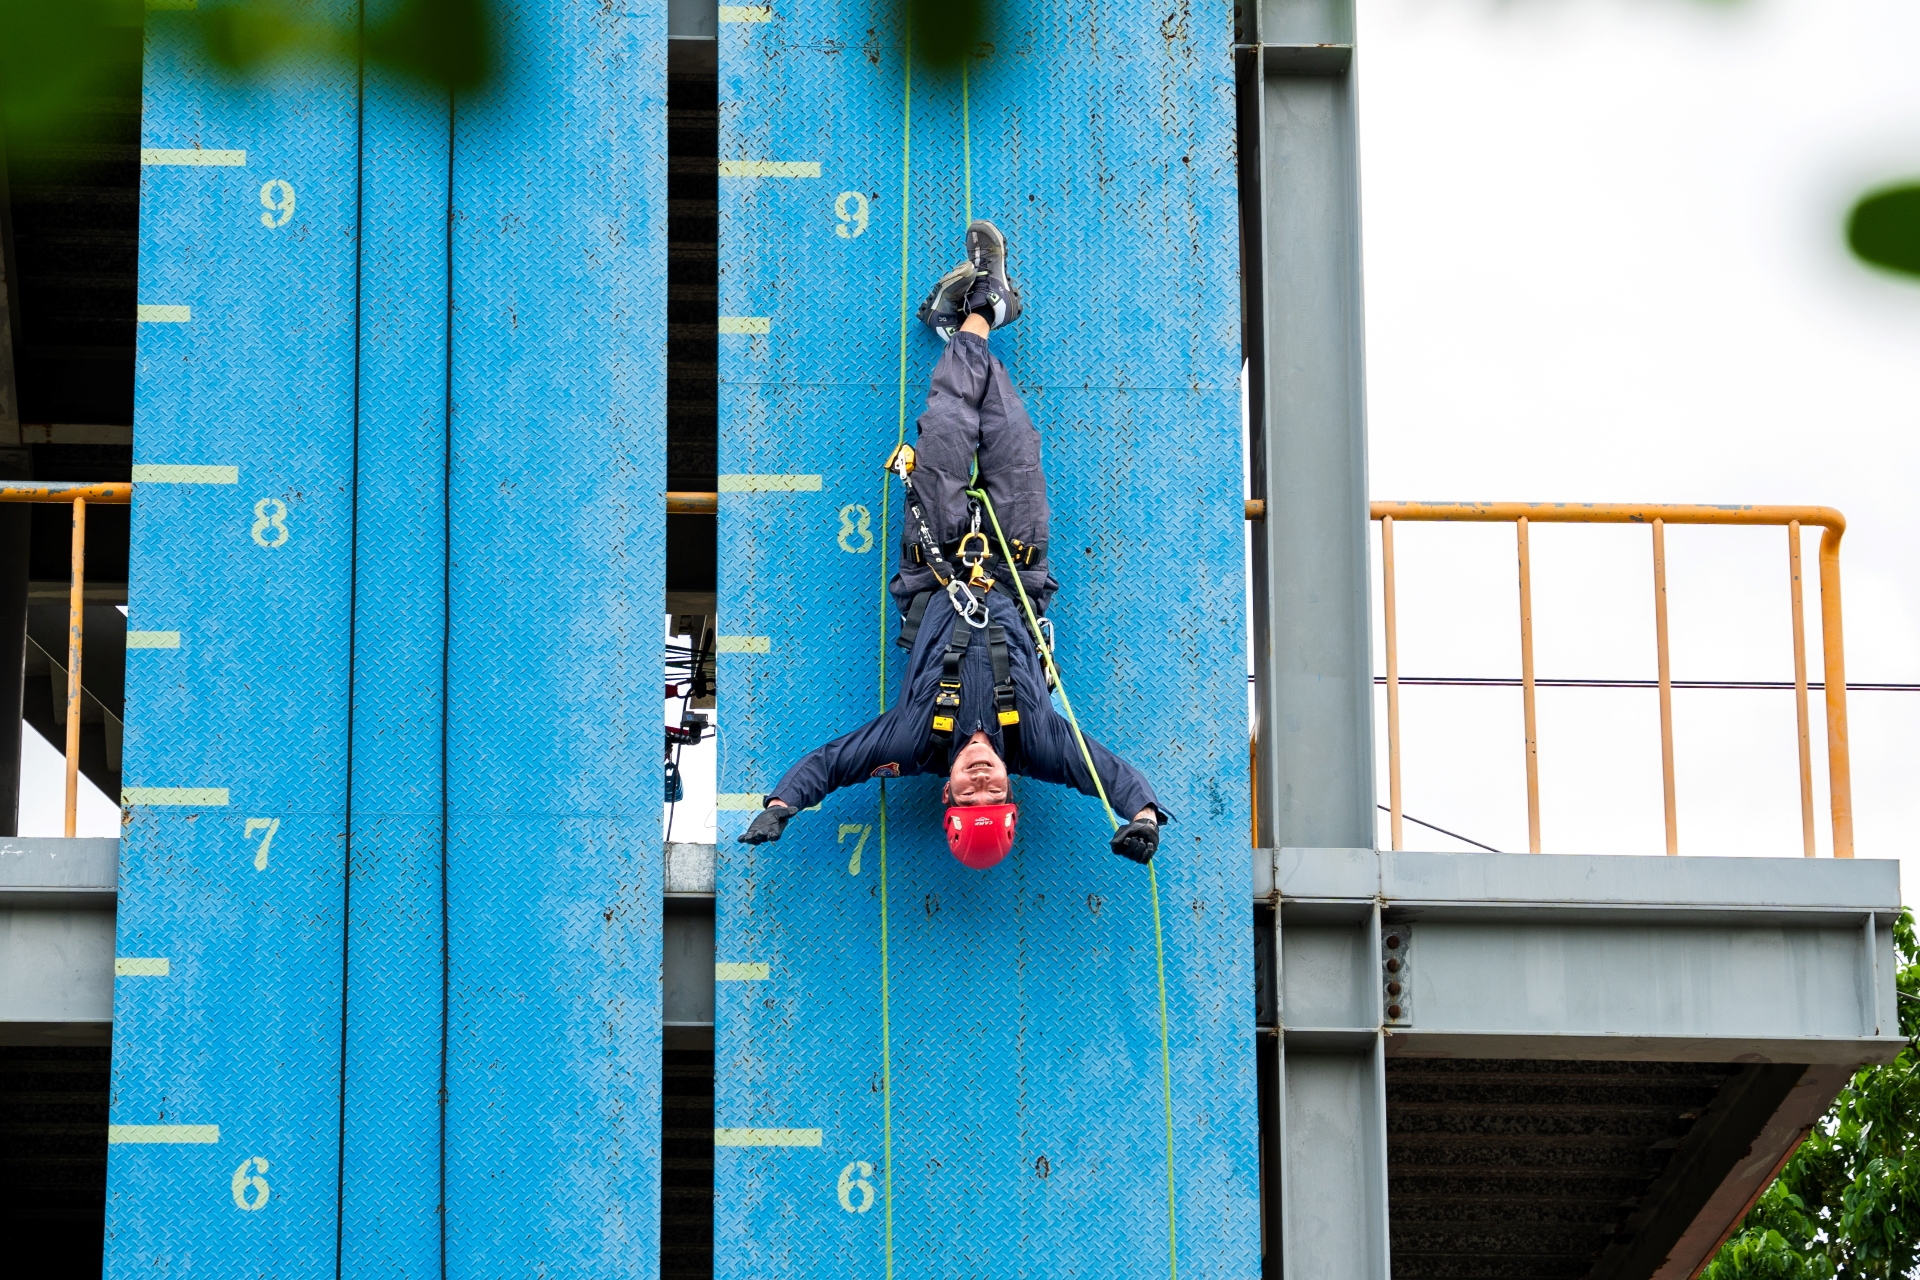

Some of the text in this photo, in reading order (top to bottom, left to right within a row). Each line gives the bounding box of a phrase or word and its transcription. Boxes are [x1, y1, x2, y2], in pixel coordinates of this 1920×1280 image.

[260, 179, 296, 229] 9
[834, 190, 870, 239] 9
[251, 497, 289, 548] 8
[838, 504, 873, 554] 8
[244, 818, 280, 871] 7
[838, 823, 872, 877] 7
[231, 1156, 270, 1211] 6
[837, 1161, 874, 1213] 6
